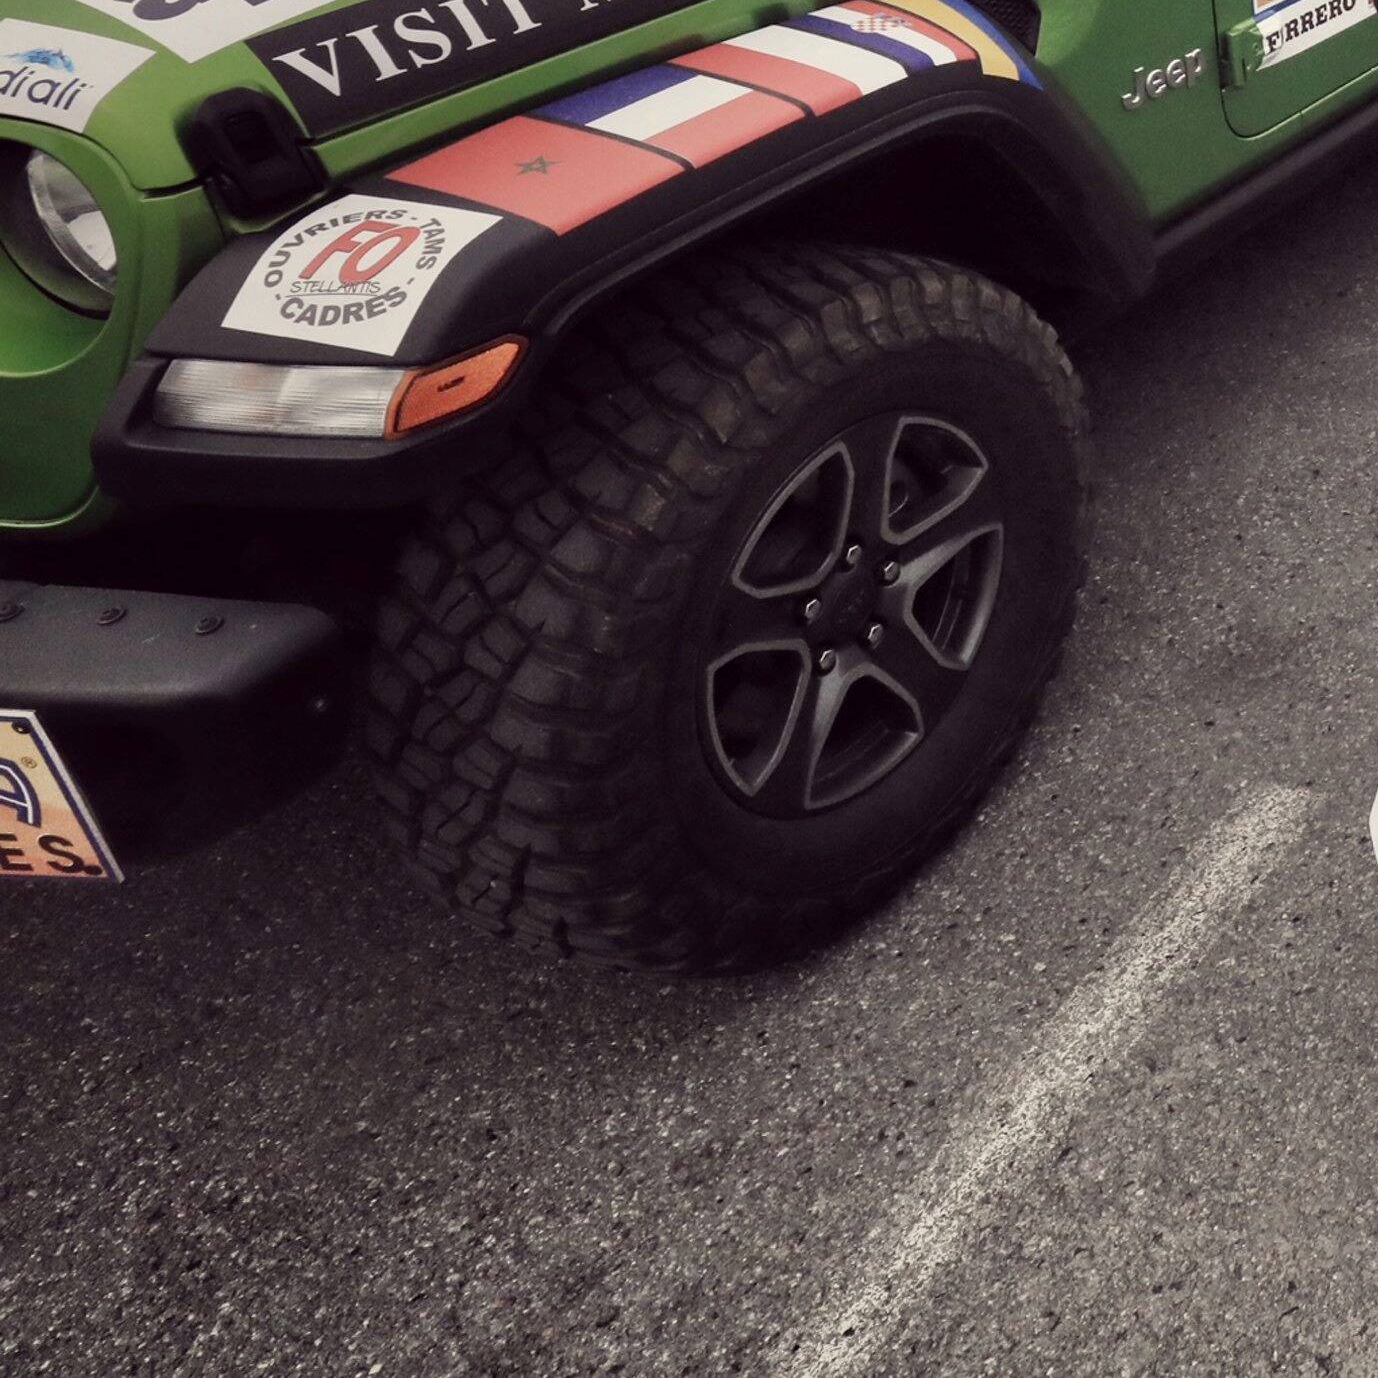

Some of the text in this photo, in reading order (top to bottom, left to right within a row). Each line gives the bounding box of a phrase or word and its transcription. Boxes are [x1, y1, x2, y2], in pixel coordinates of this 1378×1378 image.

[1121, 46, 1206, 110] Jeep
[298, 221, 423, 284] FO
[279, 287, 407, 327] CADRES
[290, 280, 382, 296] STELLANTIS
